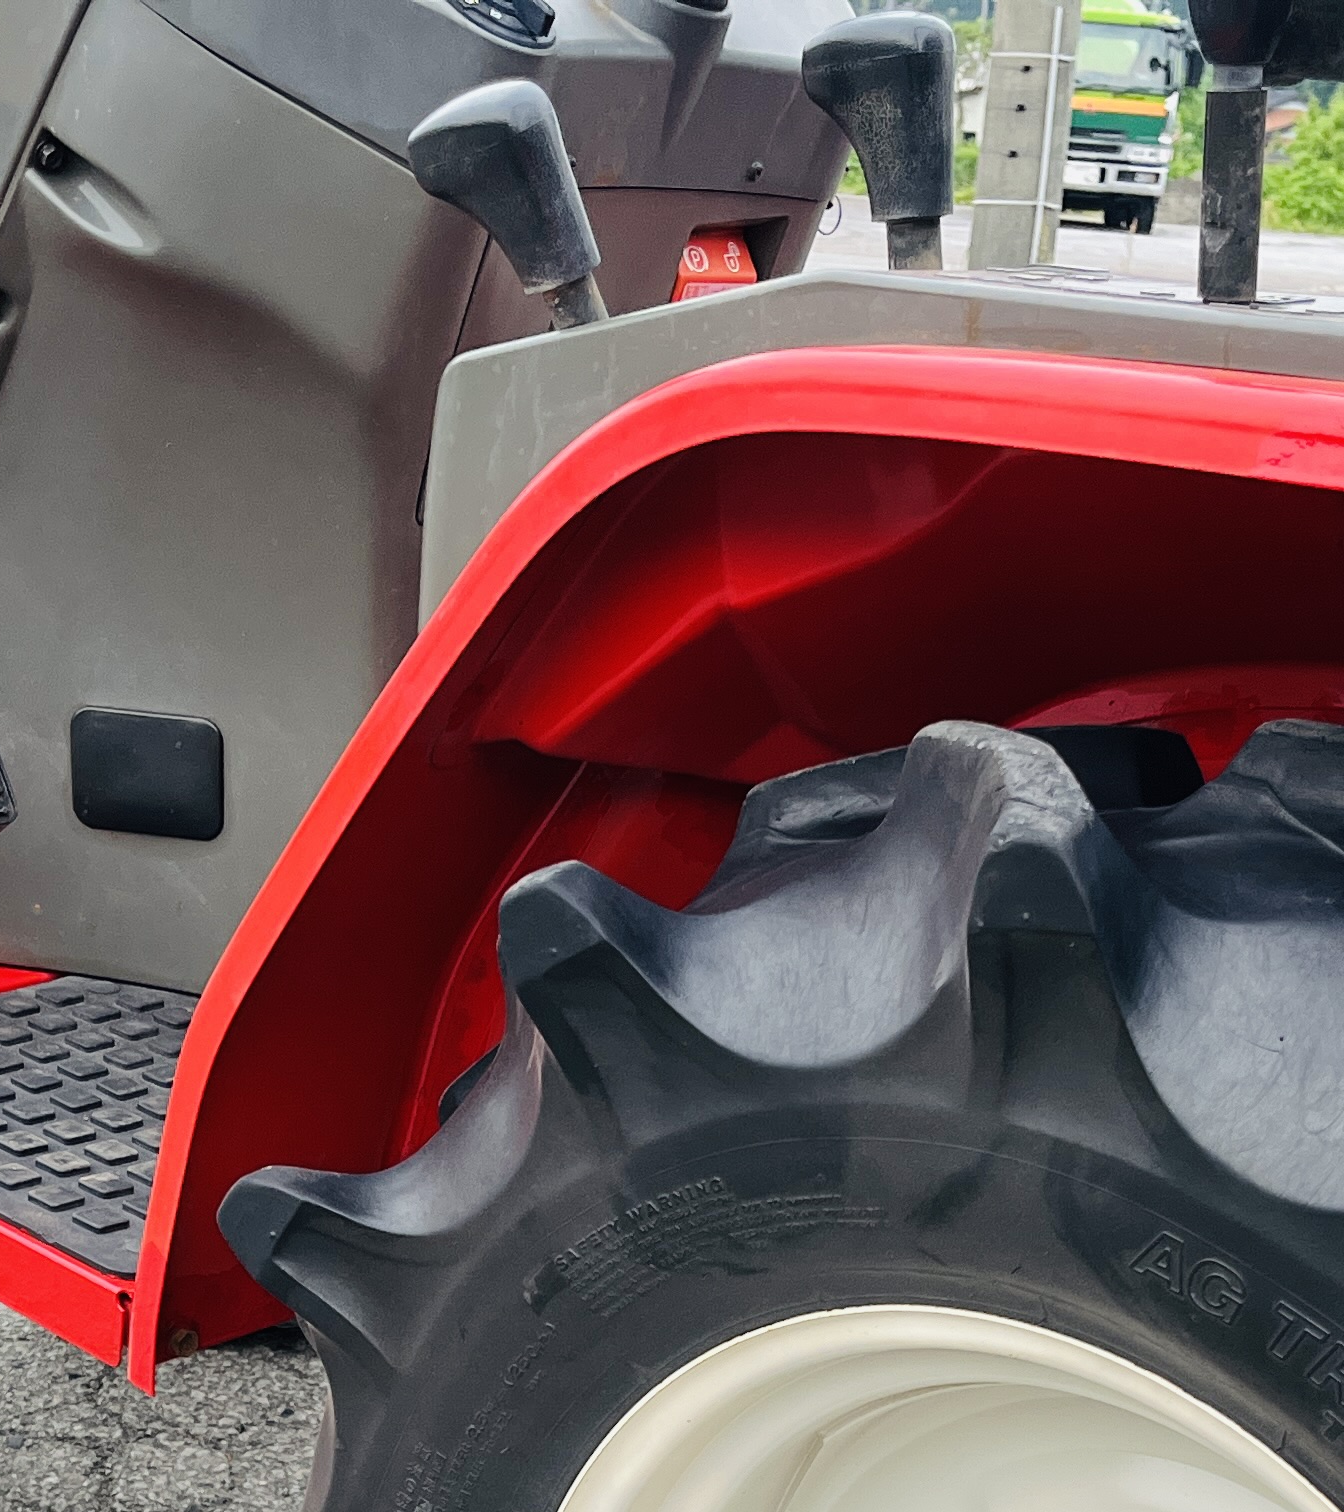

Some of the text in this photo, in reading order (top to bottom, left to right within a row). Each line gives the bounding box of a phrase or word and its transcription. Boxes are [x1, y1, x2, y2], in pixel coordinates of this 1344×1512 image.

[555, 1176, 725, 1272] SAFETY WARNING
[1129, 1230, 1248, 1326] AG
